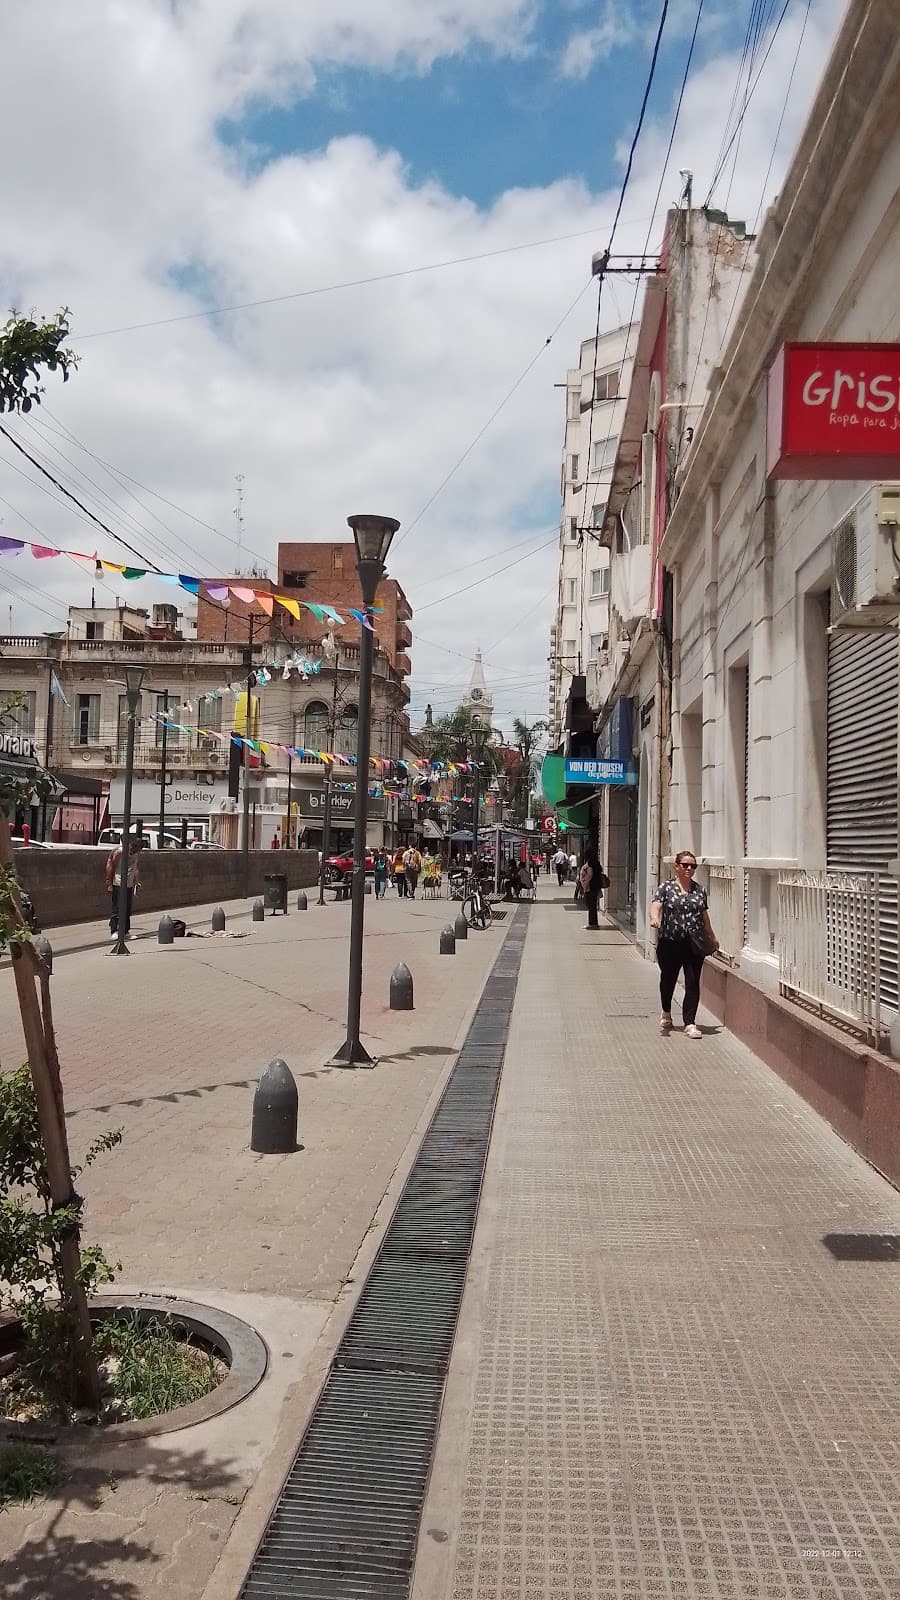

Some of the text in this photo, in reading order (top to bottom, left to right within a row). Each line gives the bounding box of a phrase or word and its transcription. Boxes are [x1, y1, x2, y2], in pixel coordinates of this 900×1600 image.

[803, 369, 900, 413] Gris
[829, 413, 859, 427] Ropa
[569, 762, 583, 772] VON
[584, 762, 597, 772] DER
[588, 772, 624, 780] deportes
[175, 790, 216, 804] Berkley
[320, 793, 352, 809] Brkley
